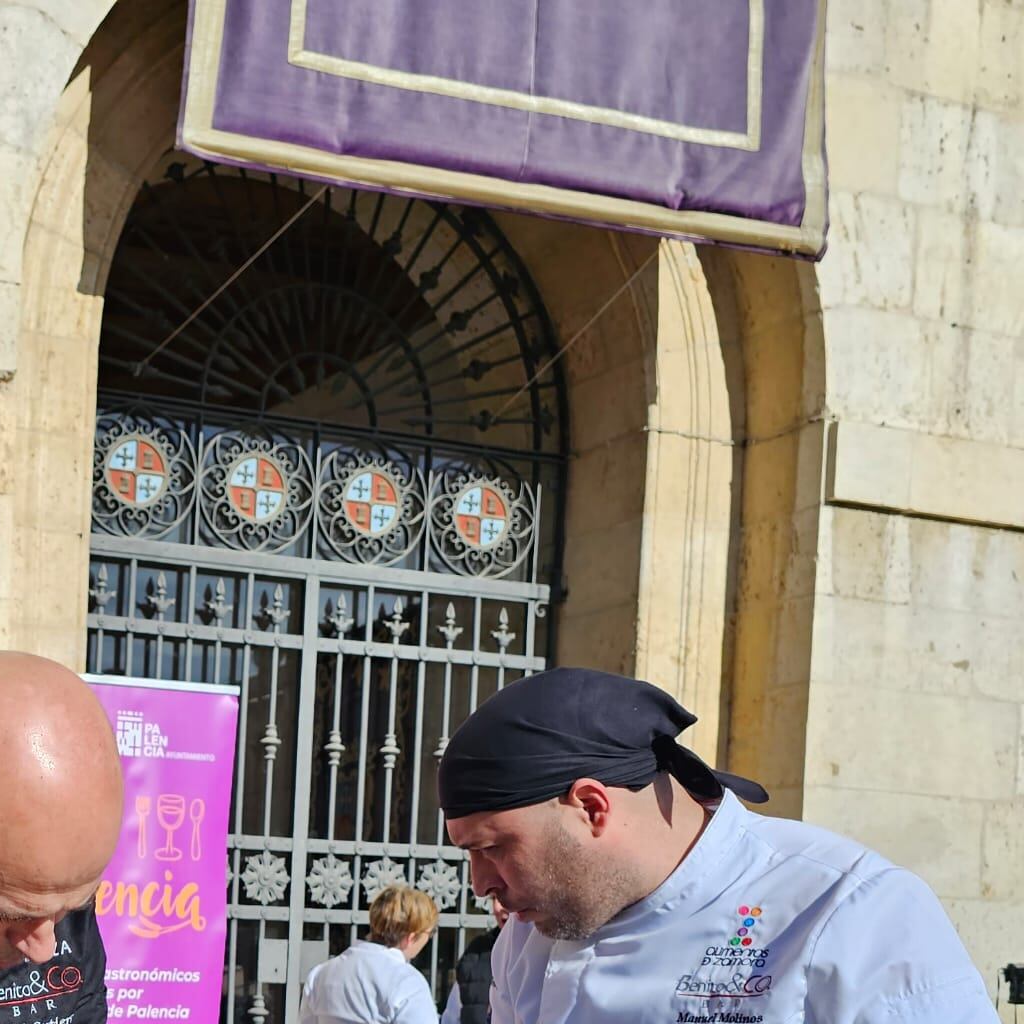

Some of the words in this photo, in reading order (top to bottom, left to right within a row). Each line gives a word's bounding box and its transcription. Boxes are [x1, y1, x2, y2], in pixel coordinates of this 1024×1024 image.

[144, 723, 161, 735] PA
[144, 735, 168, 747] LEN
[143, 746, 165, 758] CIA
[95, 870, 206, 931] encia
[104, 968, 201, 982] astronómicos
[117, 987, 144, 1001] por
[127, 1004, 190, 1019] Palencia
[718, 1012, 764, 1024] Molinos
